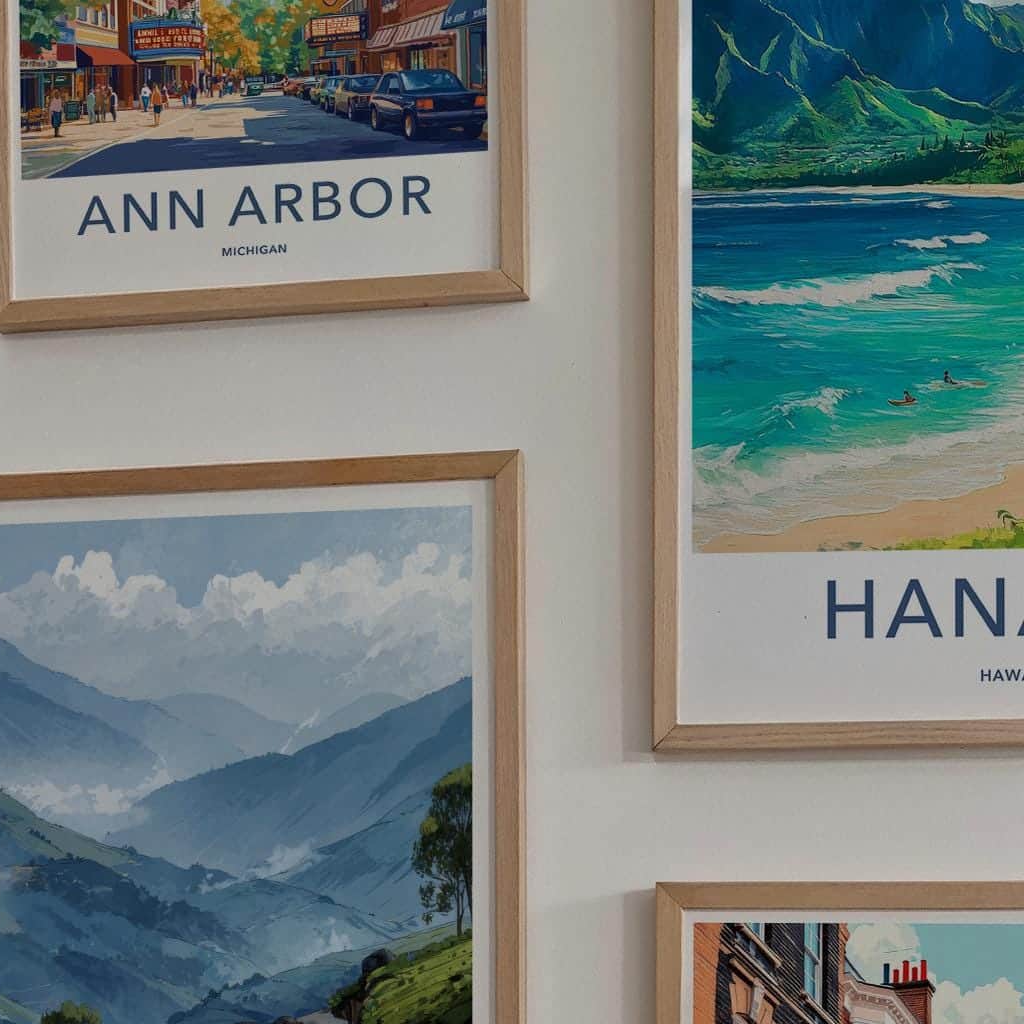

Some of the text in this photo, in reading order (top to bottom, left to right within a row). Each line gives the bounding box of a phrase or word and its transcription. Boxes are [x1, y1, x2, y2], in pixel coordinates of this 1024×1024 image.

[76, 175, 432, 236] ANN ARBOR
[221, 243, 288, 257] MICHIGAN
[826, 577, 1024, 639] HAN
[980, 669, 1024, 682] HAW
